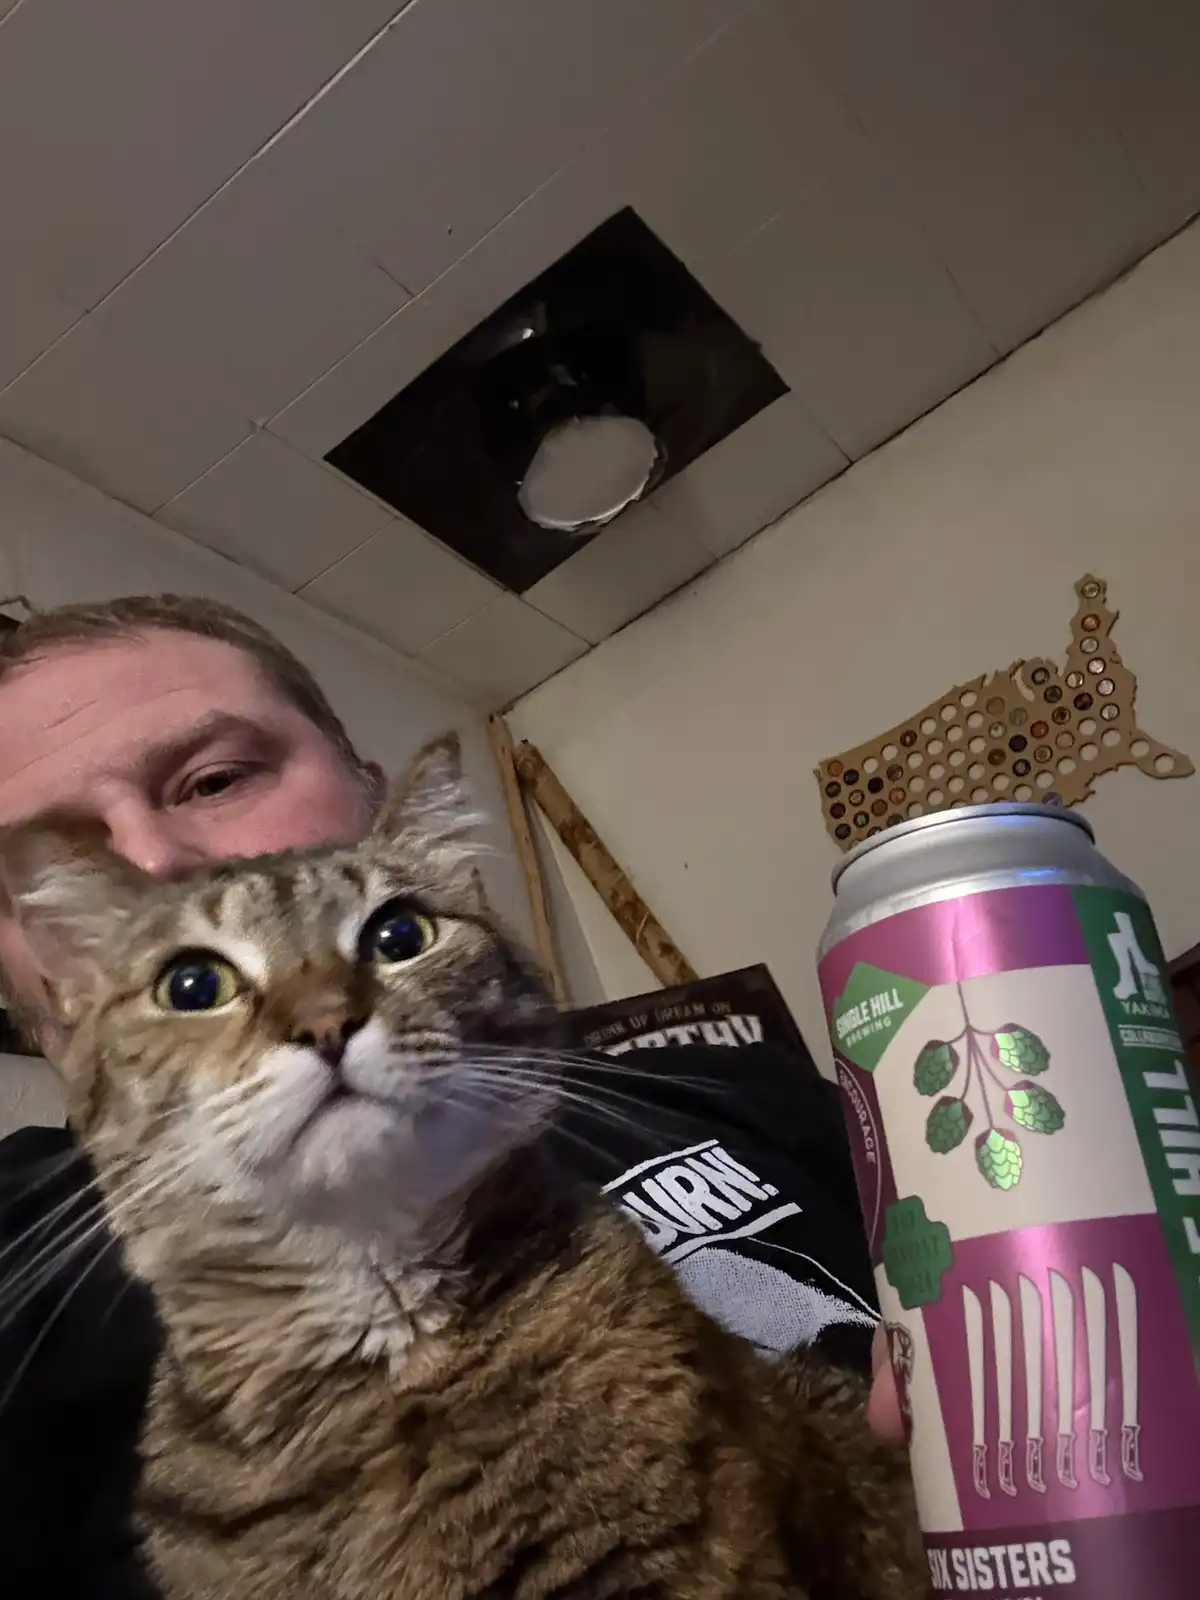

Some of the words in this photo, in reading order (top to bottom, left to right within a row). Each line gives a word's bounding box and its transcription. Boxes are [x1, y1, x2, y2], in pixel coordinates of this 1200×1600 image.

[869, 987, 904, 1018] HILL
[628, 1013, 648, 1030] UP
[845, 1016, 892, 1048] BREWING
[927, 1548, 953, 1589] SIX
[952, 1539, 1077, 1591] SISTERS
